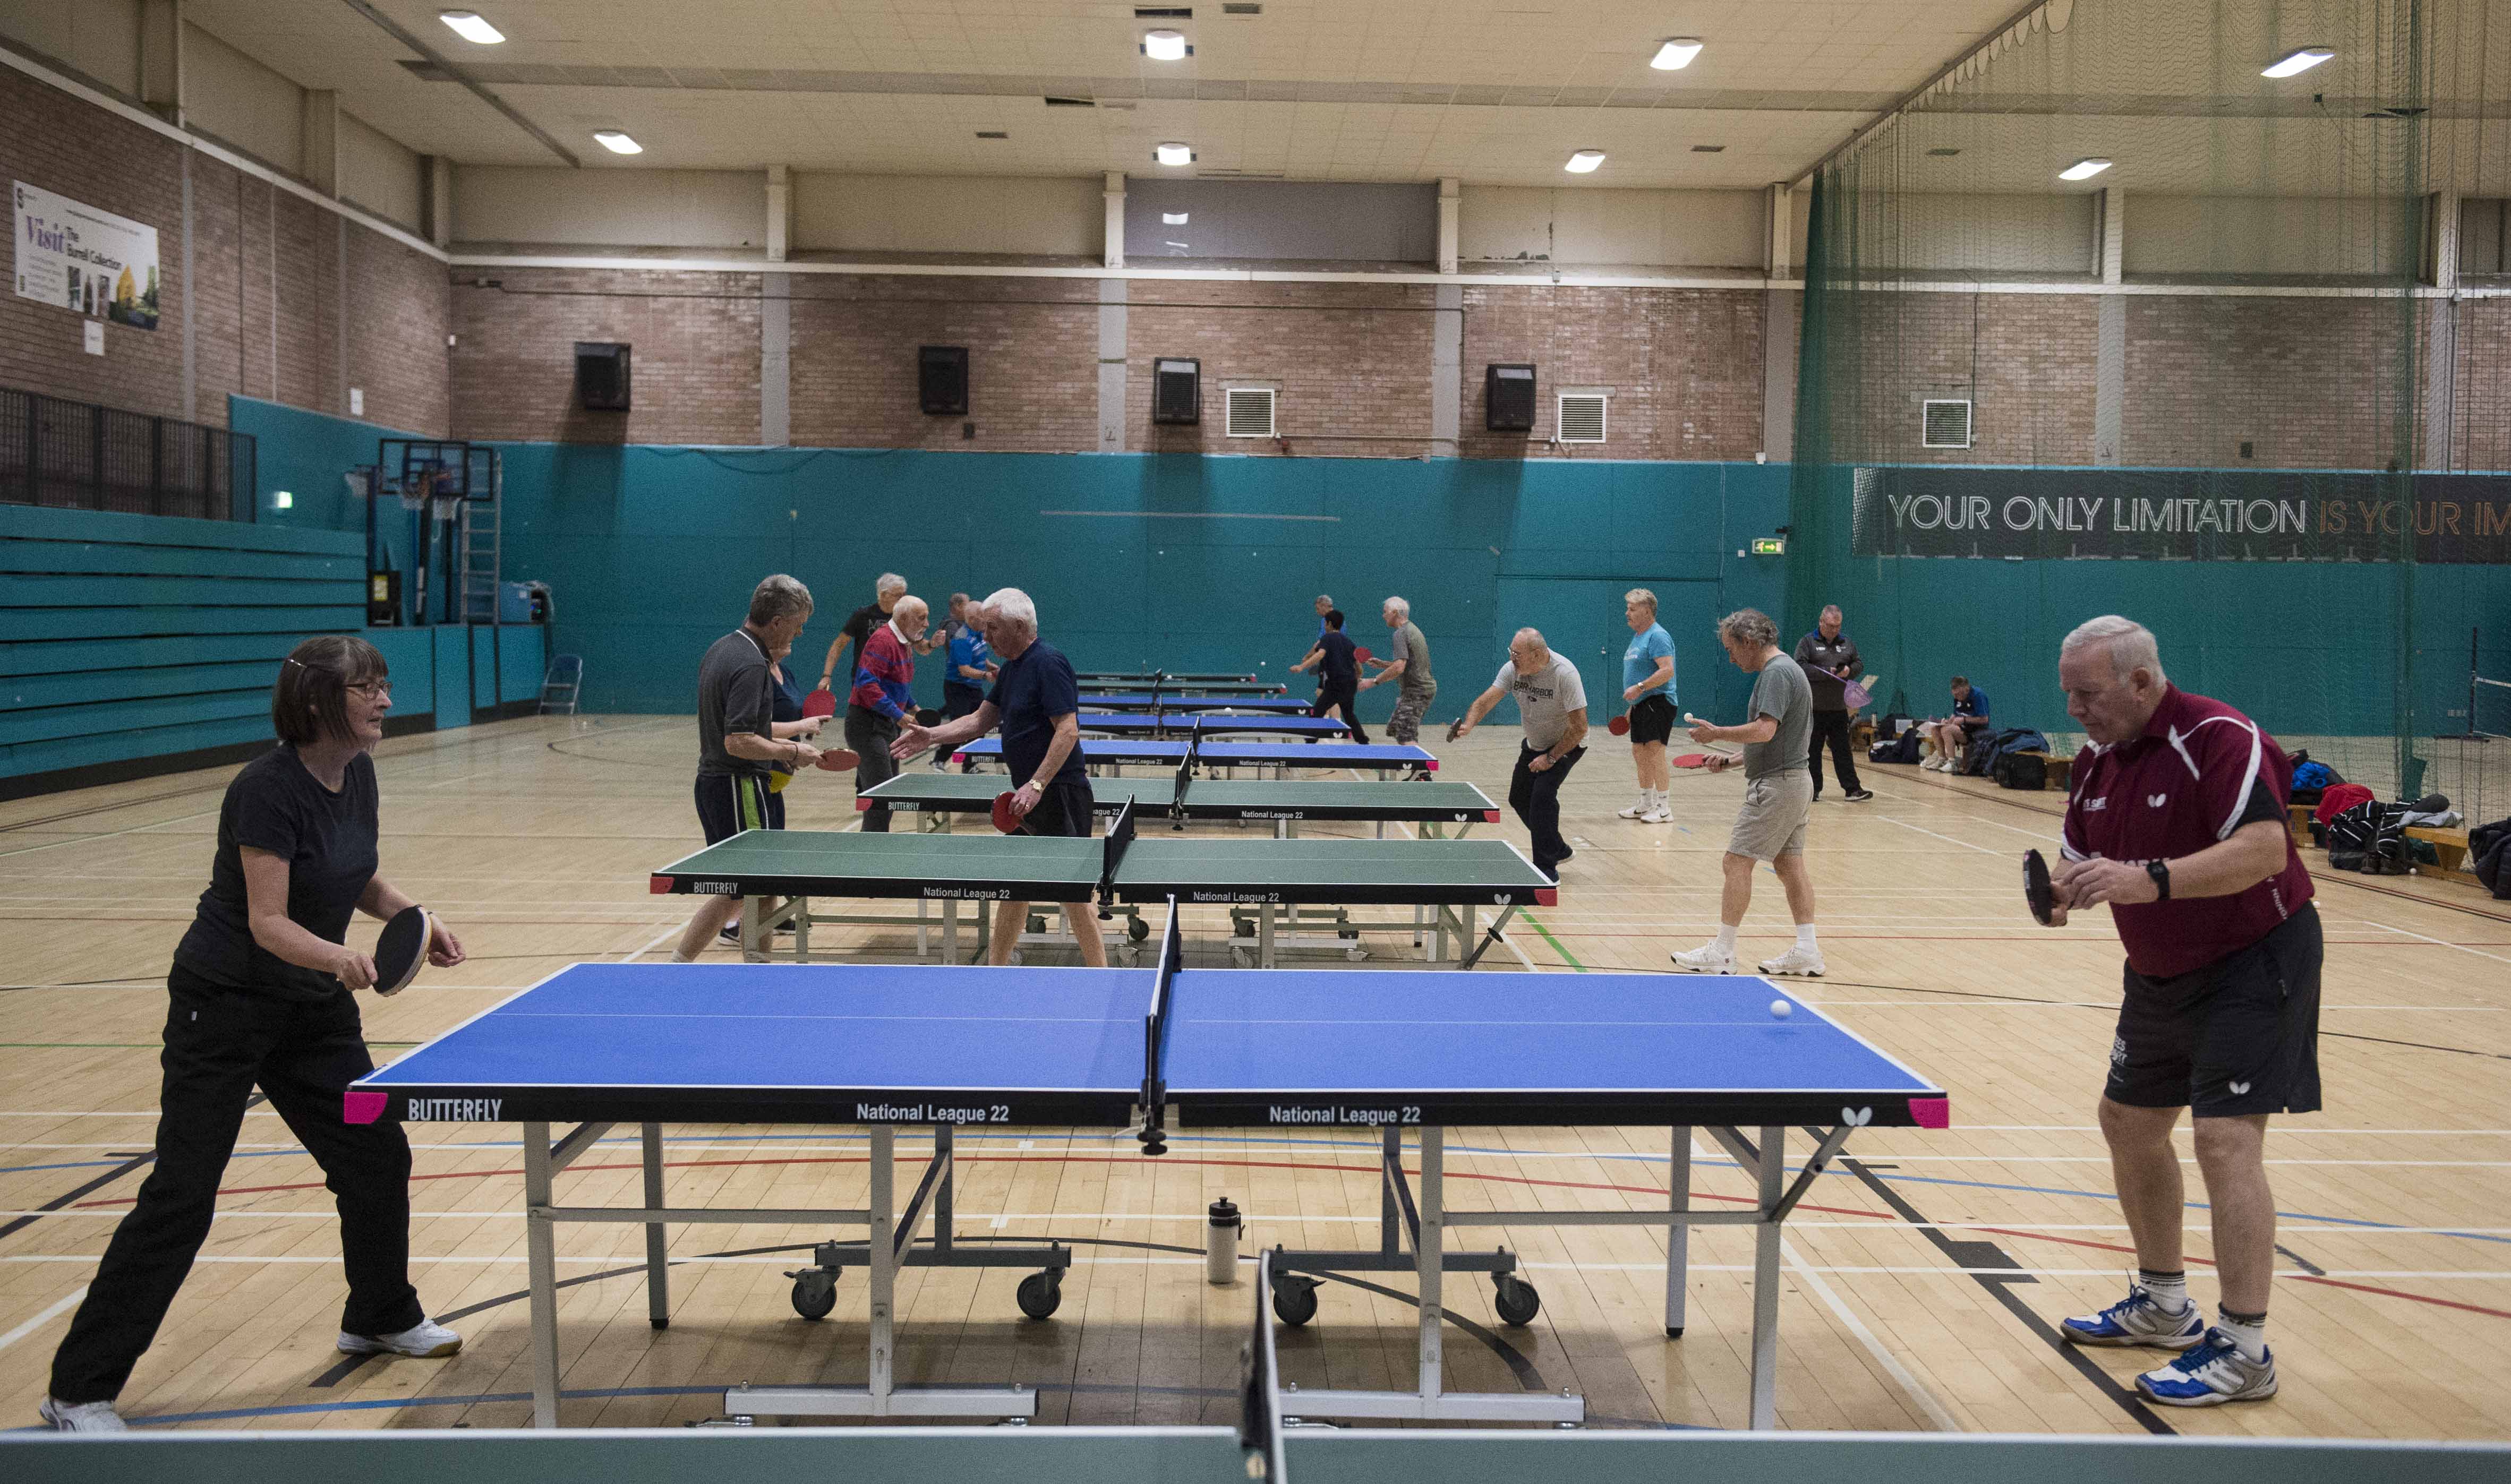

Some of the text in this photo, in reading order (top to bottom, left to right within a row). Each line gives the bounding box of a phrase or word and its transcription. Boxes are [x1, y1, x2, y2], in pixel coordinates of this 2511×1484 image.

[26, 215, 64, 253] Visit
[1888, 495, 1991, 529] YOUR
[2003, 496, 2103, 530] ONLY
[2113, 498, 2305, 533] LIMITATION
[2320, 501, 2346, 534] IS
[2358, 501, 2461, 535] YOUR
[888, 802, 920, 810] BUTTERFLY
[694, 881, 738, 894] BUTTERFLY
[924, 887, 1010, 900] National League 22
[1193, 891, 1279, 903] National League 22
[408, 1098, 502, 1121] BUTTERFLY
[856, 1103, 1009, 1124] National League 22
[1270, 1106, 1421, 1126] National League 22
